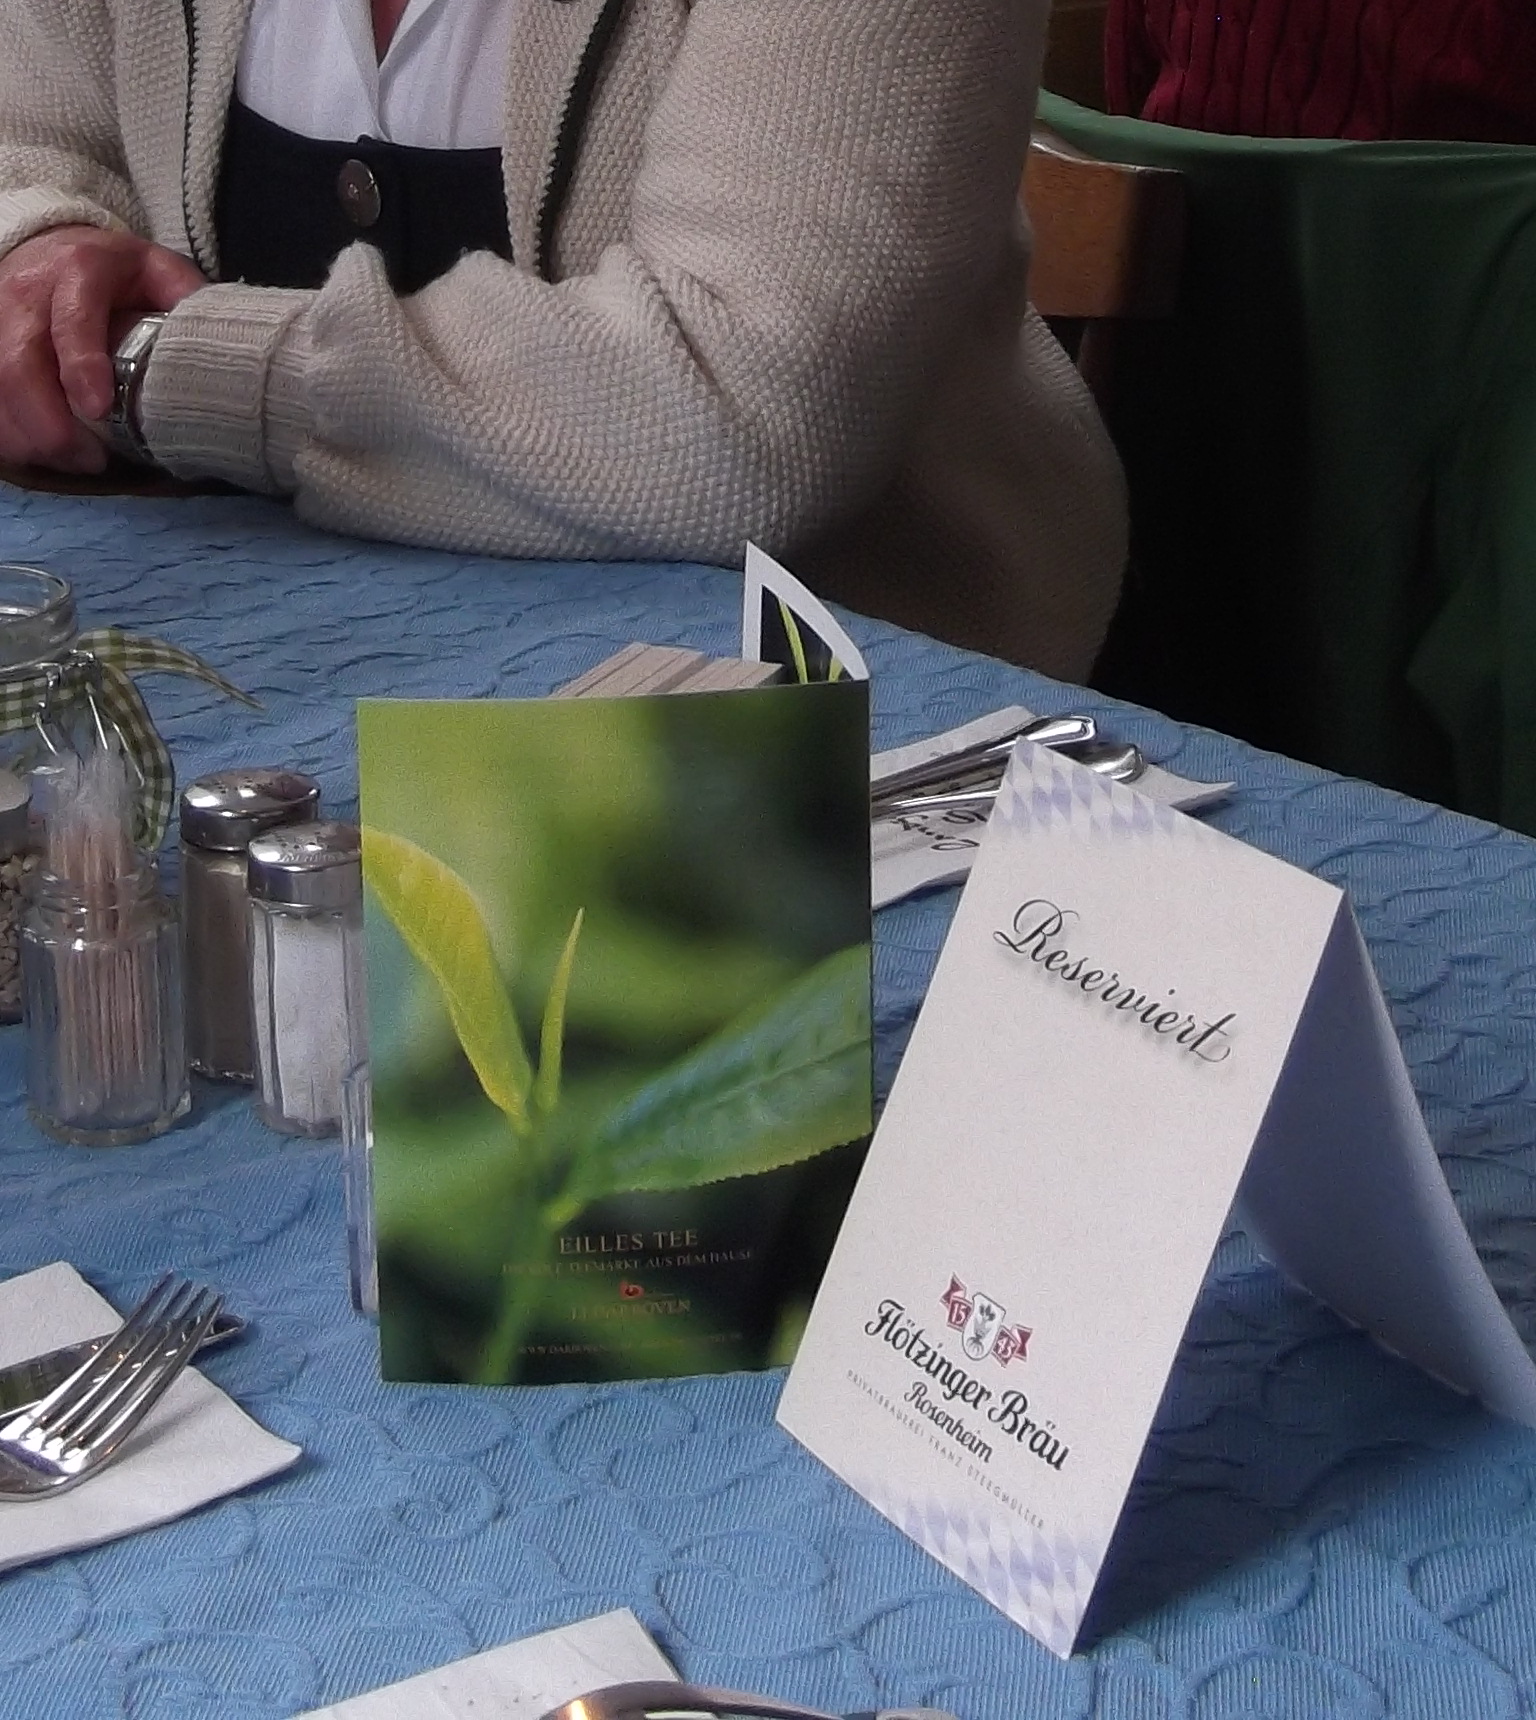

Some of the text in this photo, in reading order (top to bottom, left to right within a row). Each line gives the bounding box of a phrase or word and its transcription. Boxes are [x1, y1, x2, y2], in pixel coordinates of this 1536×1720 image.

[992, 898, 1237, 1063] Reserviert
[559, 1229, 699, 1256] EILLES TEE
[864, 1298, 1070, 1472] Flötzinger Bräu
[903, 1380, 994, 1464] Rosenheim
